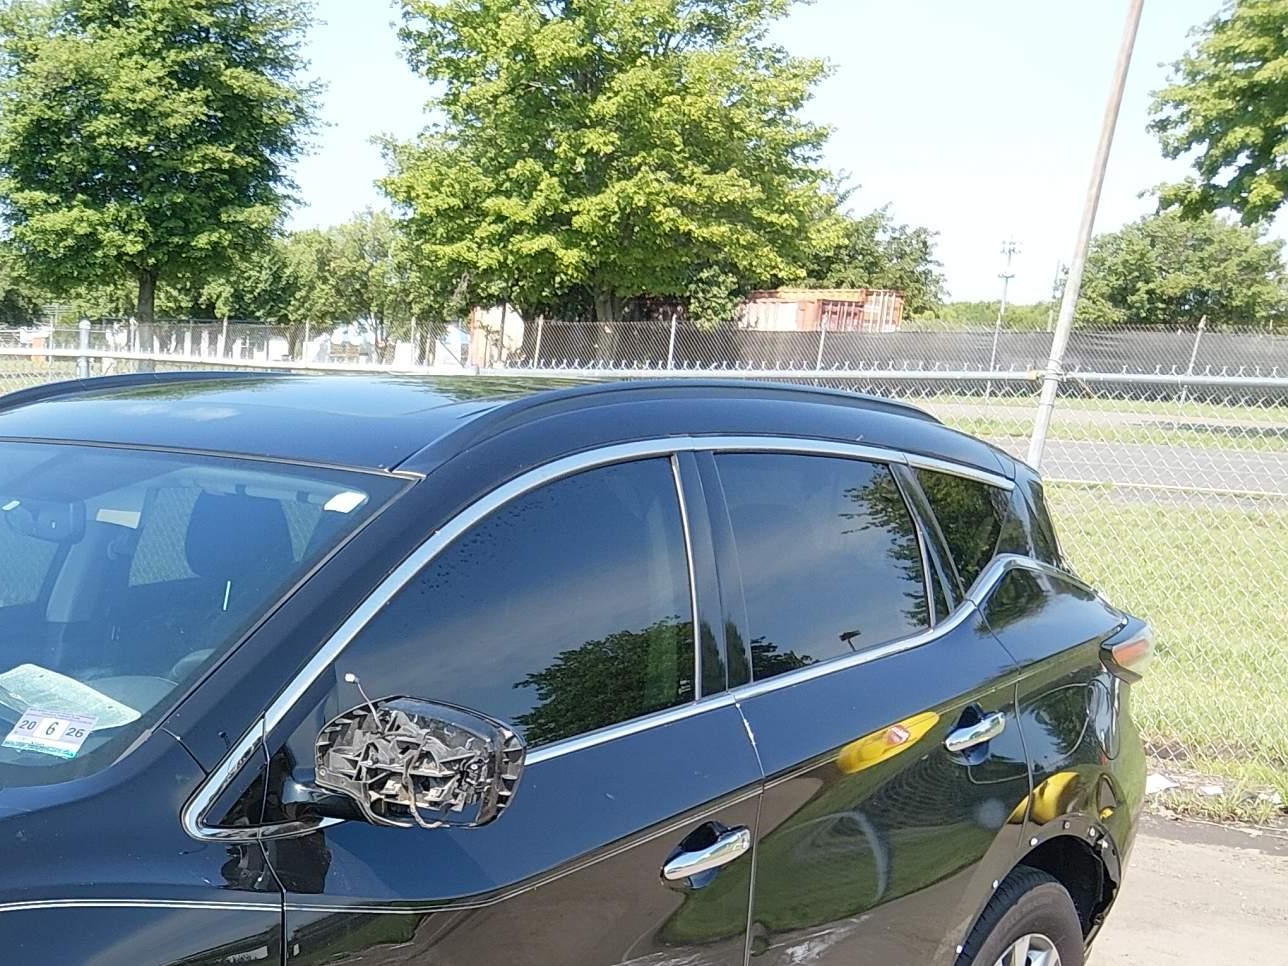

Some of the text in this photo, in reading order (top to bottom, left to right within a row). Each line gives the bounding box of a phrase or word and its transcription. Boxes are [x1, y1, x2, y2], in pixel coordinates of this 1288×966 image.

[19, 720, 86, 738] 20 6 26
